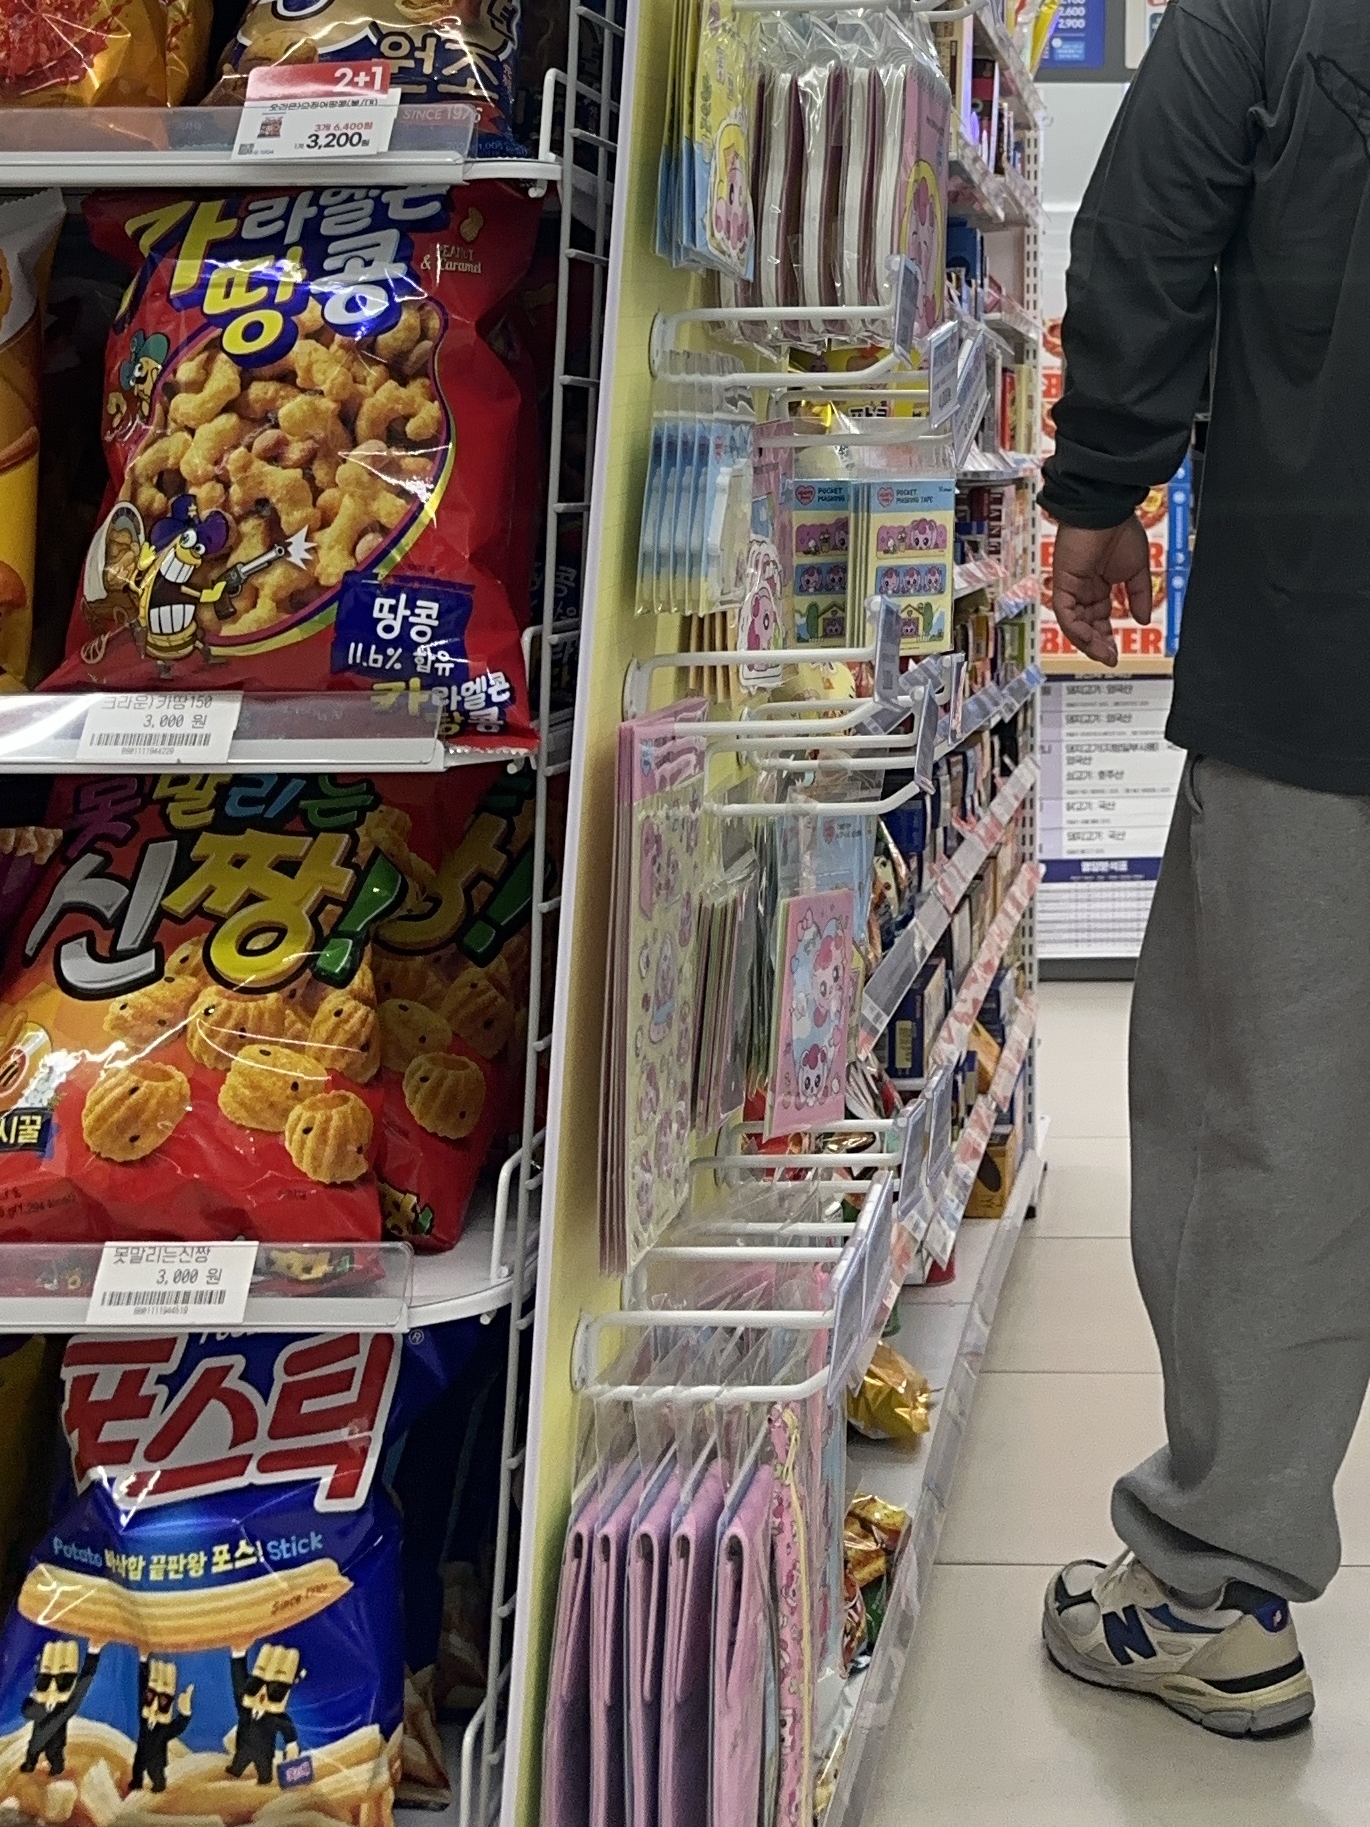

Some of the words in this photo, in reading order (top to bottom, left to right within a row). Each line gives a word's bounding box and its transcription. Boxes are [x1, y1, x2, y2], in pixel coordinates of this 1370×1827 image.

[333, 65, 384, 93] 2+1
[403, 107, 442, 121] SINCE
[373, 593, 440, 643] 땅콩
[347, 641, 403, 671] 11.6%
[412, 645, 455, 677] 함유
[142, 714, 185, 729] 3,000
[190, 713, 208, 730] 원
[24, 827, 405, 996] 신짱!
[112, 1245, 211, 1264] 못말리는신짱
[156, 1268, 199, 1285] 3,000
[205, 1267, 223, 1285] 원
[62, 1332, 397, 1507] 포스틱
[52, 1535, 103, 1568] Potato
[149, 1551, 208, 1582] 끝판왕
[266, 1531, 323, 1562] Stick
